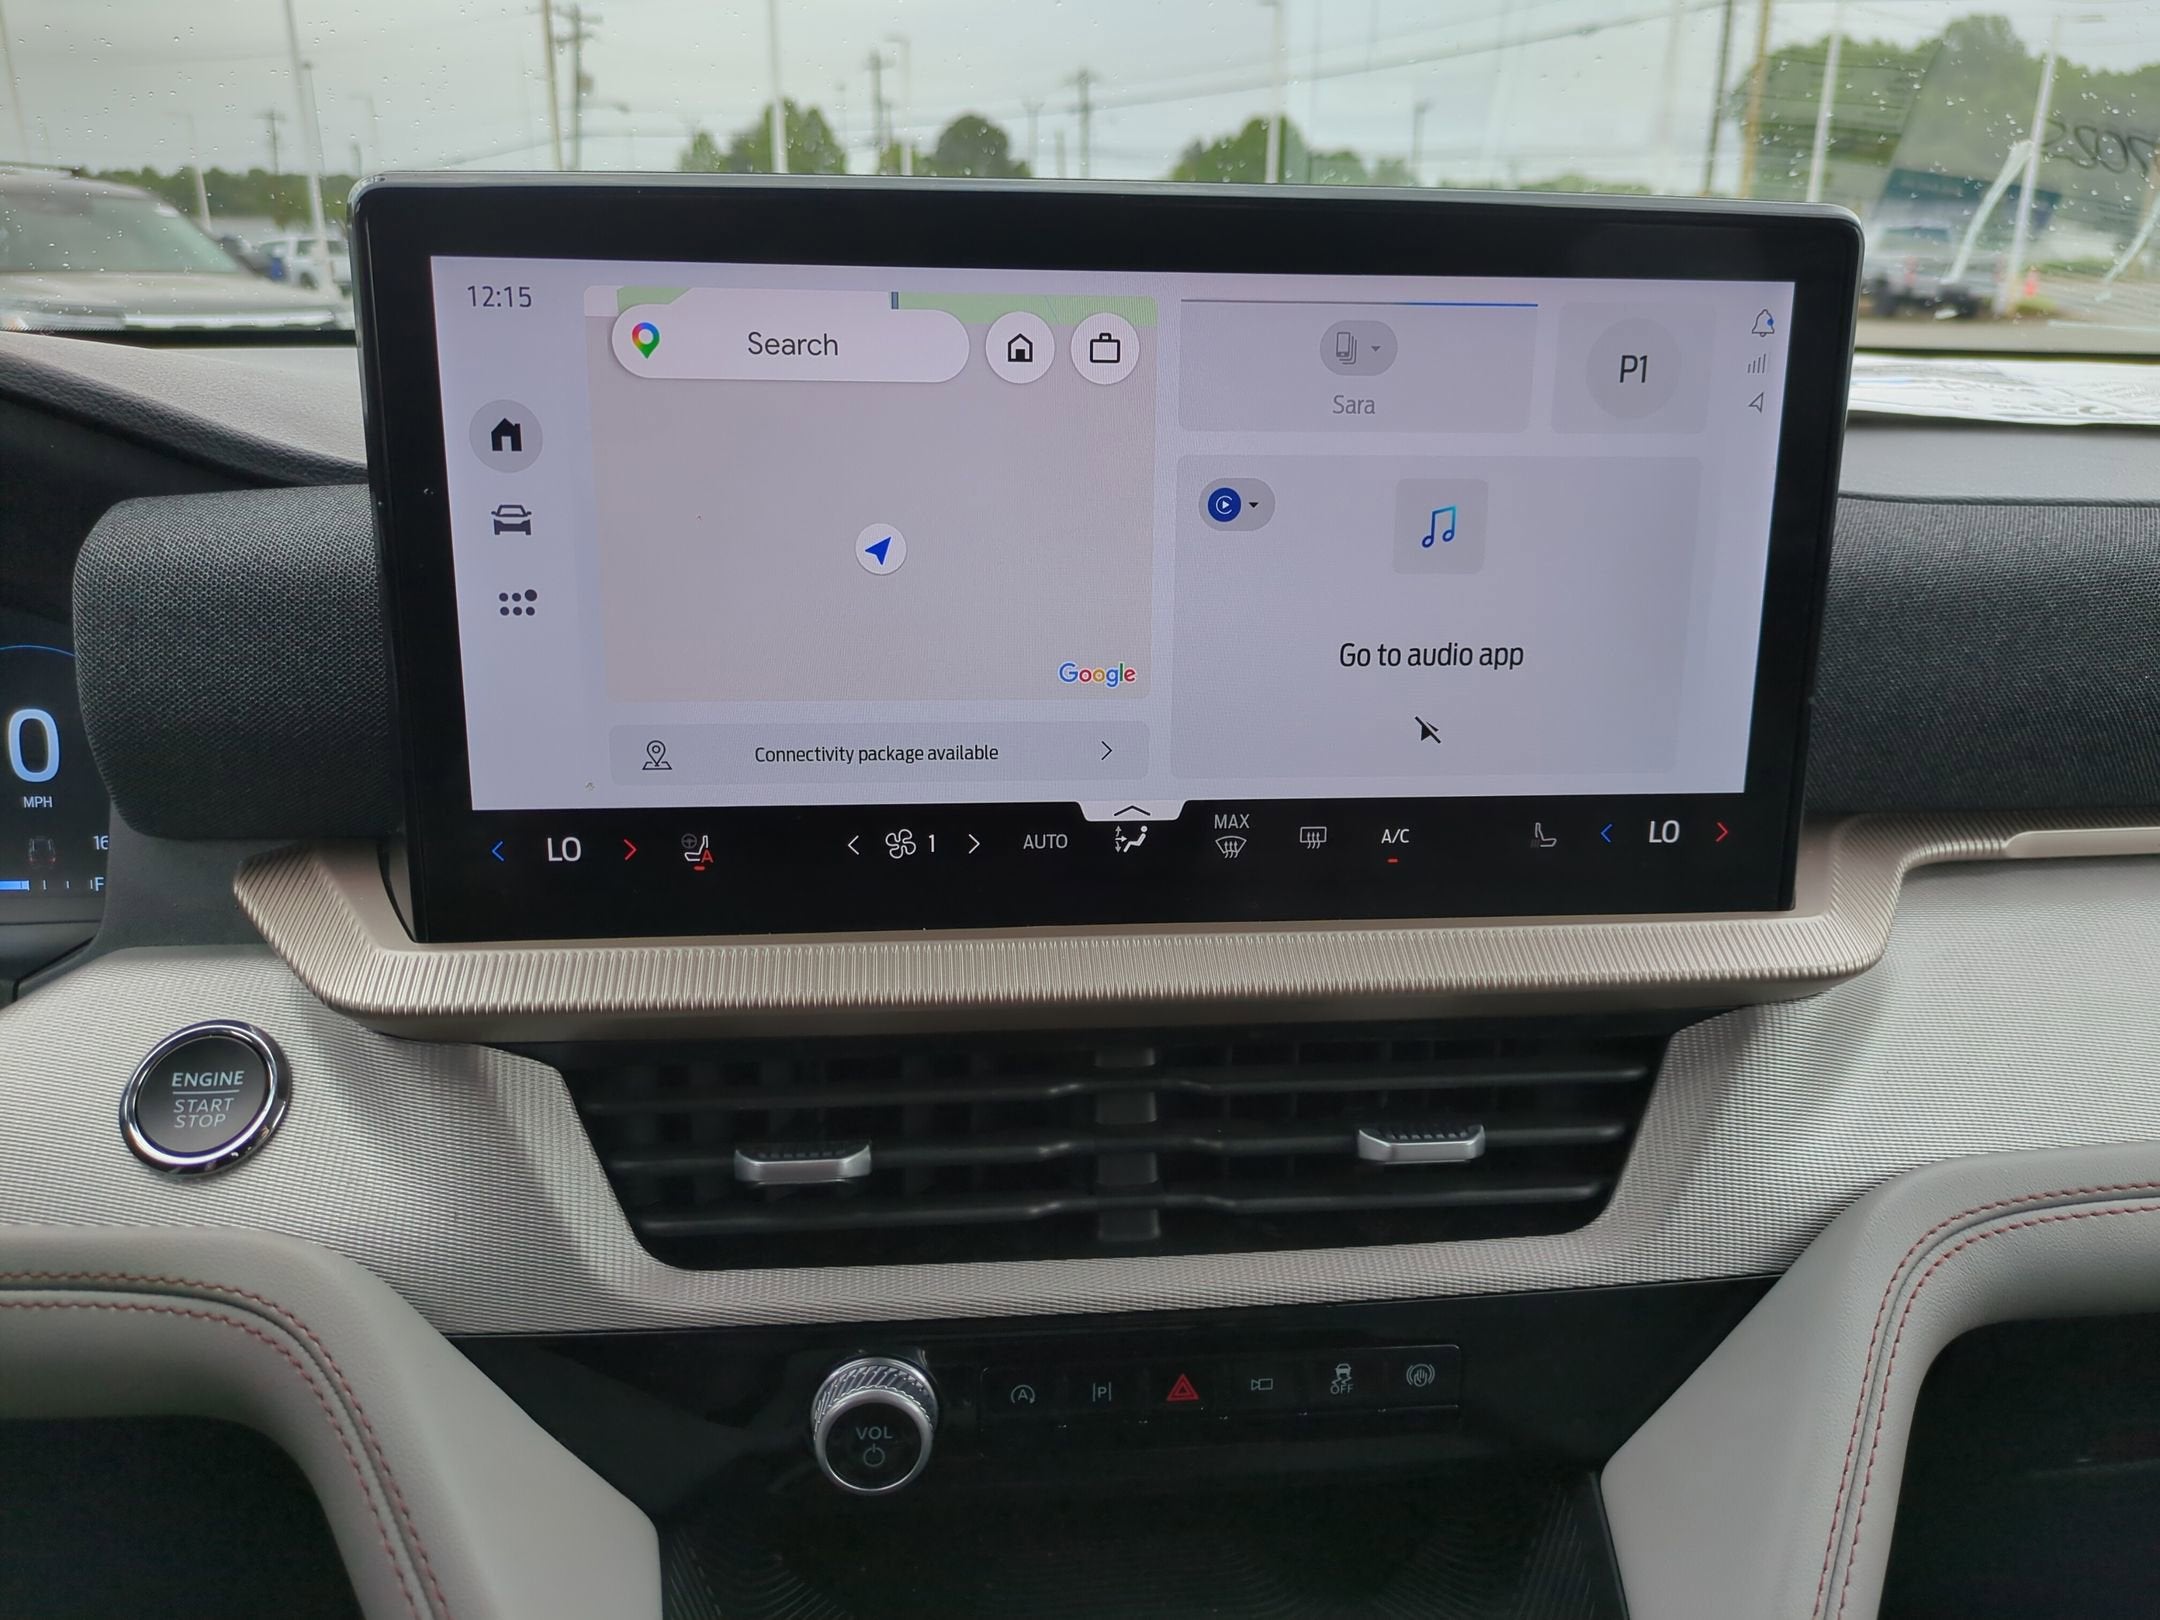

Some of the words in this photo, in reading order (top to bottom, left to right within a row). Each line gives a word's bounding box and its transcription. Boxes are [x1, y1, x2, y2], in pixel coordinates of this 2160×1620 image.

[467, 285, 532, 307] 12:15
[748, 331, 839, 356] Search
[1619, 354, 1648, 384] P1
[1332, 394, 1376, 415] Sara
[1339, 642, 1371, 667] Go
[1377, 643, 1401, 667] to
[1407, 642, 1473, 667] audio
[1479, 647, 1524, 670] app
[1058, 661, 1137, 688] Google
[8, 709, 60, 783] 0
[755, 746, 854, 765] Connectivity
[858, 745, 924, 765] package
[927, 744, 999, 761] available
[23, 795, 53, 808] MPH
[1214, 813, 1250, 829] MAX
[1381, 828, 1410, 844] A/C
[1648, 819, 1680, 844] LO
[547, 836, 582, 862] LO
[928, 834, 936, 853] 1
[1023, 833, 1068, 850] AUTO
[94, 876, 105, 892] F
[171, 1070, 245, 1087] ENGINE
[173, 1097, 234, 1113] START
[174, 1113, 226, 1128] STOP
[1330, 1383, 1354, 1396] OFF
[855, 1426, 893, 1440] VOL
